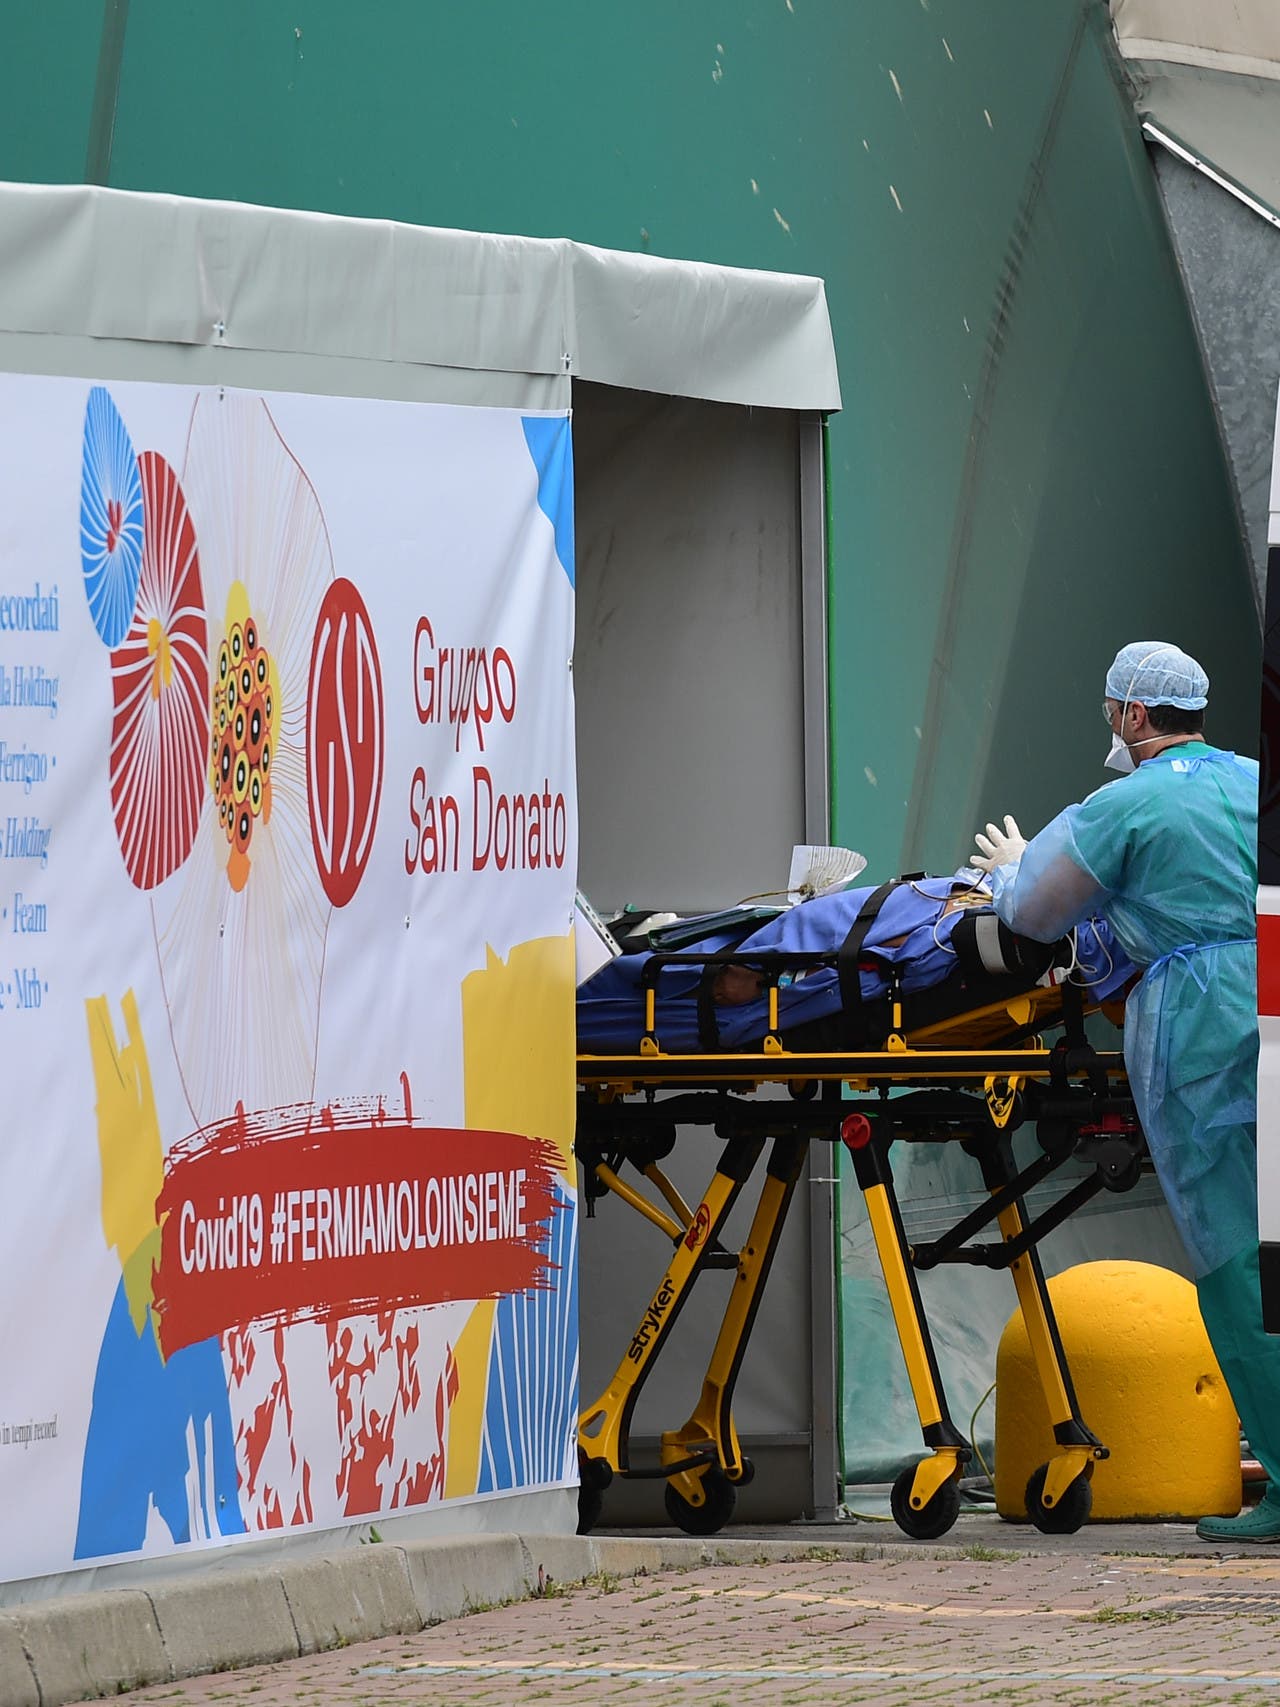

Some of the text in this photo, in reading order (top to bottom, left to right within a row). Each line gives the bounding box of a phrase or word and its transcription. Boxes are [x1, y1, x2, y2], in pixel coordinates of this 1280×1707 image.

[13, 666, 58, 719] Holding
[414, 615, 516, 752] Gruppo
[5, 817, 52, 870] Holding
[405, 766, 566, 875] San Donato
[14, 892, 47, 933] Feam
[180, 1168, 526, 1275] Covid19 #FERMIAMOLOINSIEME
[628, 1278, 675, 1364] stryker
